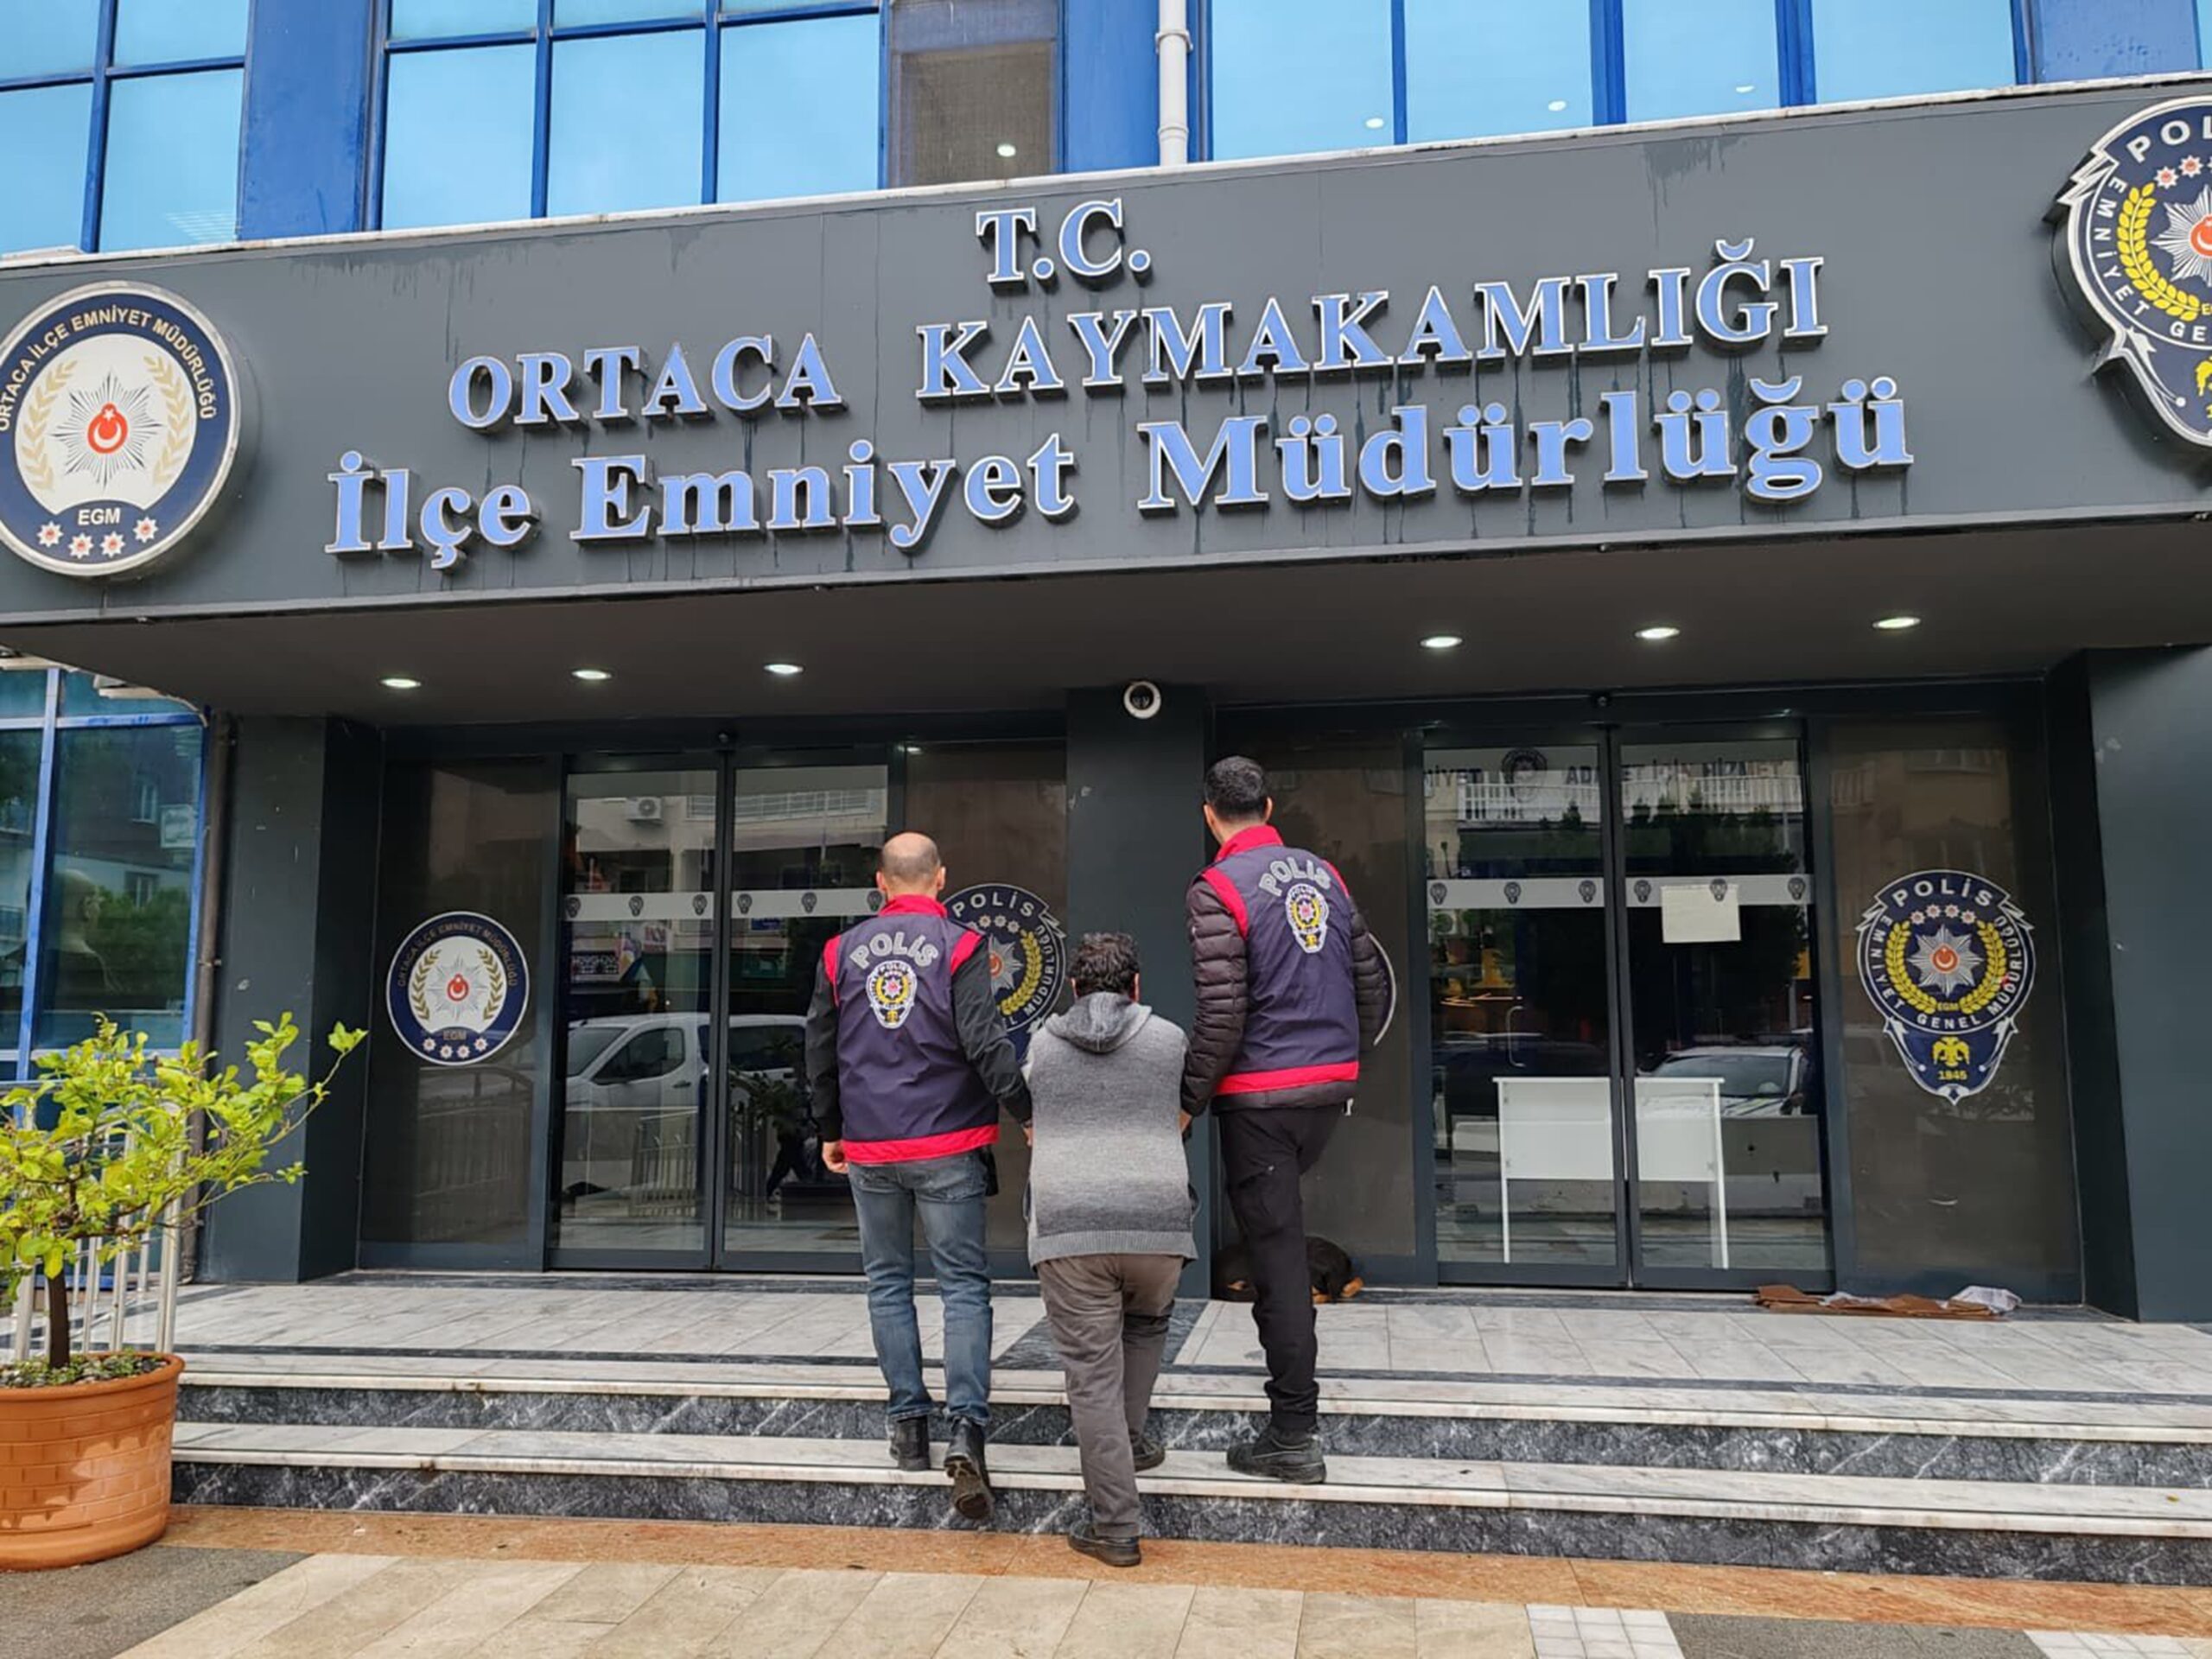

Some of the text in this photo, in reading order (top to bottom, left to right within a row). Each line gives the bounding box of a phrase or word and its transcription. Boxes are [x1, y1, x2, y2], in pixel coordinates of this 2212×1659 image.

[976, 197, 1150, 282] T.C.
[448, 238, 1827, 428] ORTACA KAYMAKAMLIĞI
[28, 322, 70, 359] İLÇE
[71, 304, 152, 333] EMNİYET
[152, 317, 217, 420] MÜDÜRLÜĞÜ
[326, 376, 1914, 569] İlçe Emniyet Müdürlüğü
[78, 507, 120, 525] EGM
[951, 891, 1035, 918] POLİS
[1892, 878, 1993, 907] POLİS
[1916, 1014, 1981, 1030] GENEL
